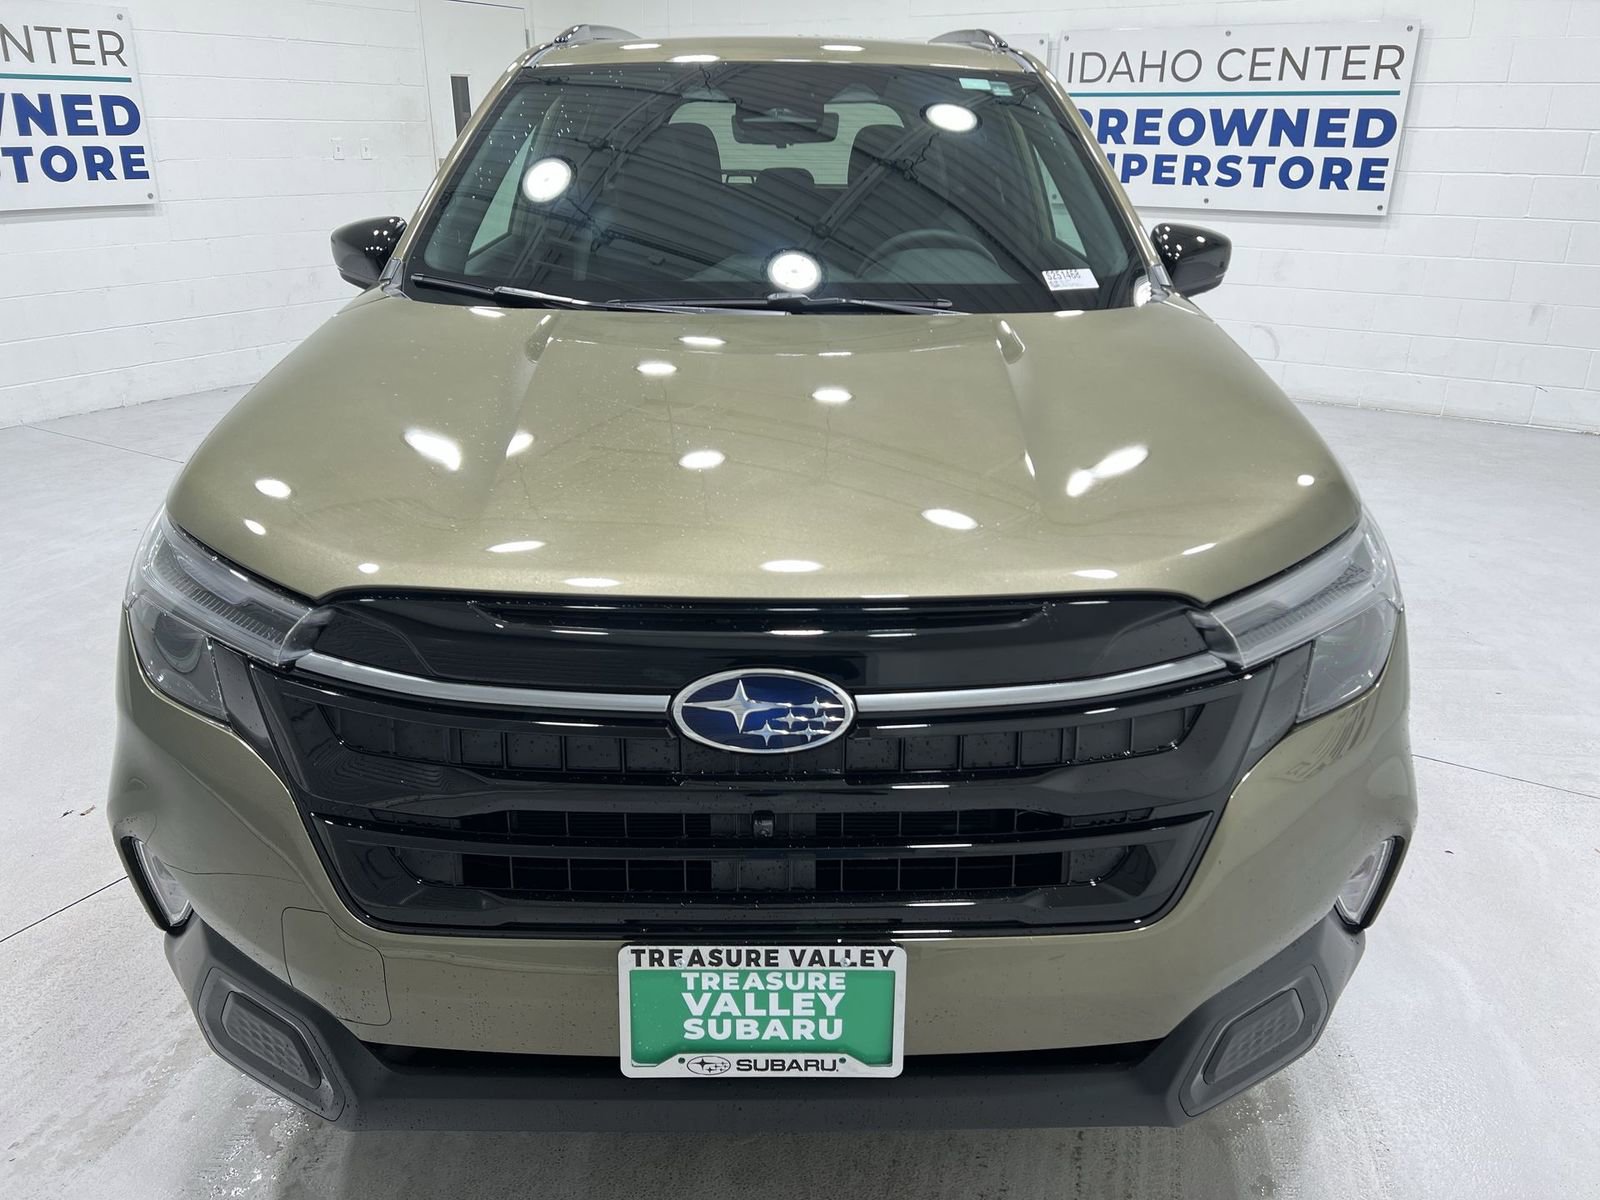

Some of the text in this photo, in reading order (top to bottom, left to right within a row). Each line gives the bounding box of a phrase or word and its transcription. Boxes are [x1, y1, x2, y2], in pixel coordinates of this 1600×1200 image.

[1067, 44, 1405, 84] IDAHO CENTER
[0, 93, 141, 136] NED
[0, 145, 150, 183] TORE
[630, 948, 895, 968] TREASURE VALLEY
[681, 972, 846, 991] TREASURE
[681, 992, 845, 1017] VALLEY
[683, 1018, 843, 1040] SUBARU
